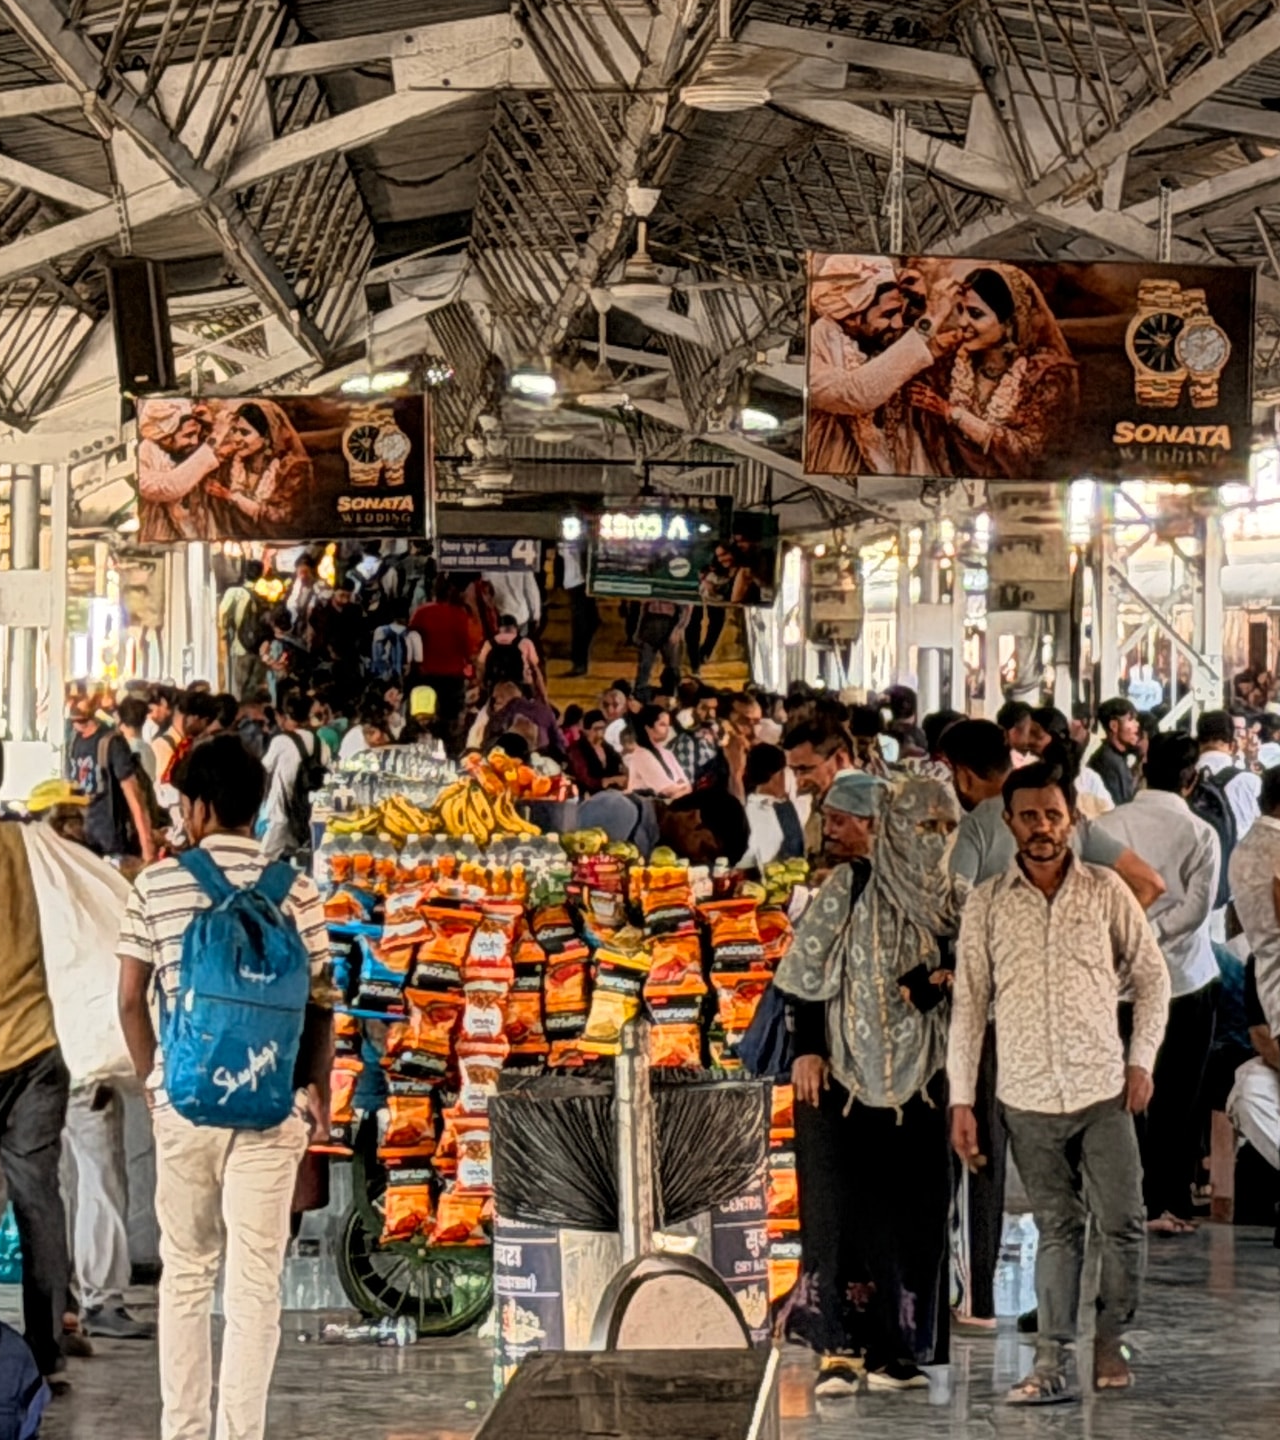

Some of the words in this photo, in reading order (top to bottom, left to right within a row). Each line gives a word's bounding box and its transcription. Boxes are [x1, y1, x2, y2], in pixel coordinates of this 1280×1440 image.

[1112, 420, 1232, 451] SONATA
[337, 495, 414, 512] SONATA
[511, 539, 536, 566] 4
